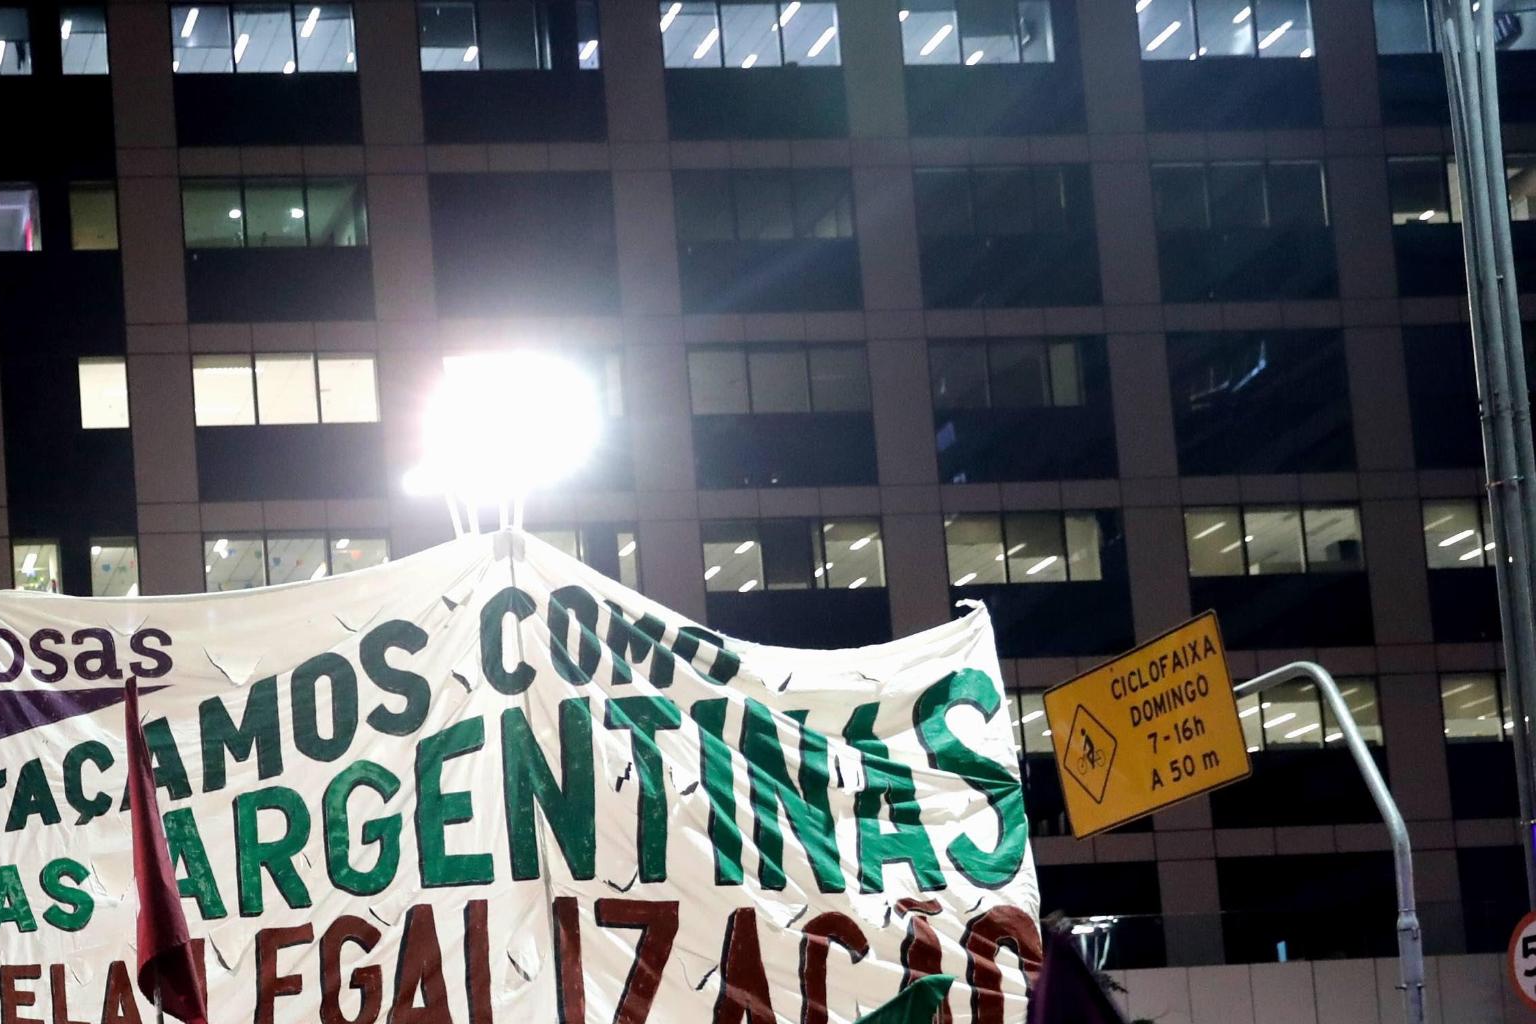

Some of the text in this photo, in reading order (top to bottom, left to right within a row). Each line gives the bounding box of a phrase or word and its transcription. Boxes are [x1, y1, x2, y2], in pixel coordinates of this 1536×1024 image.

[479, 584, 741, 697] COMO
[1111, 635, 1217, 700] CICLOFAIXA
[1130, 674, 1209, 727] DOMINGO
[162, 667, 1027, 921] ARGENTINAS
[1151, 750, 1220, 791] A 50 m
